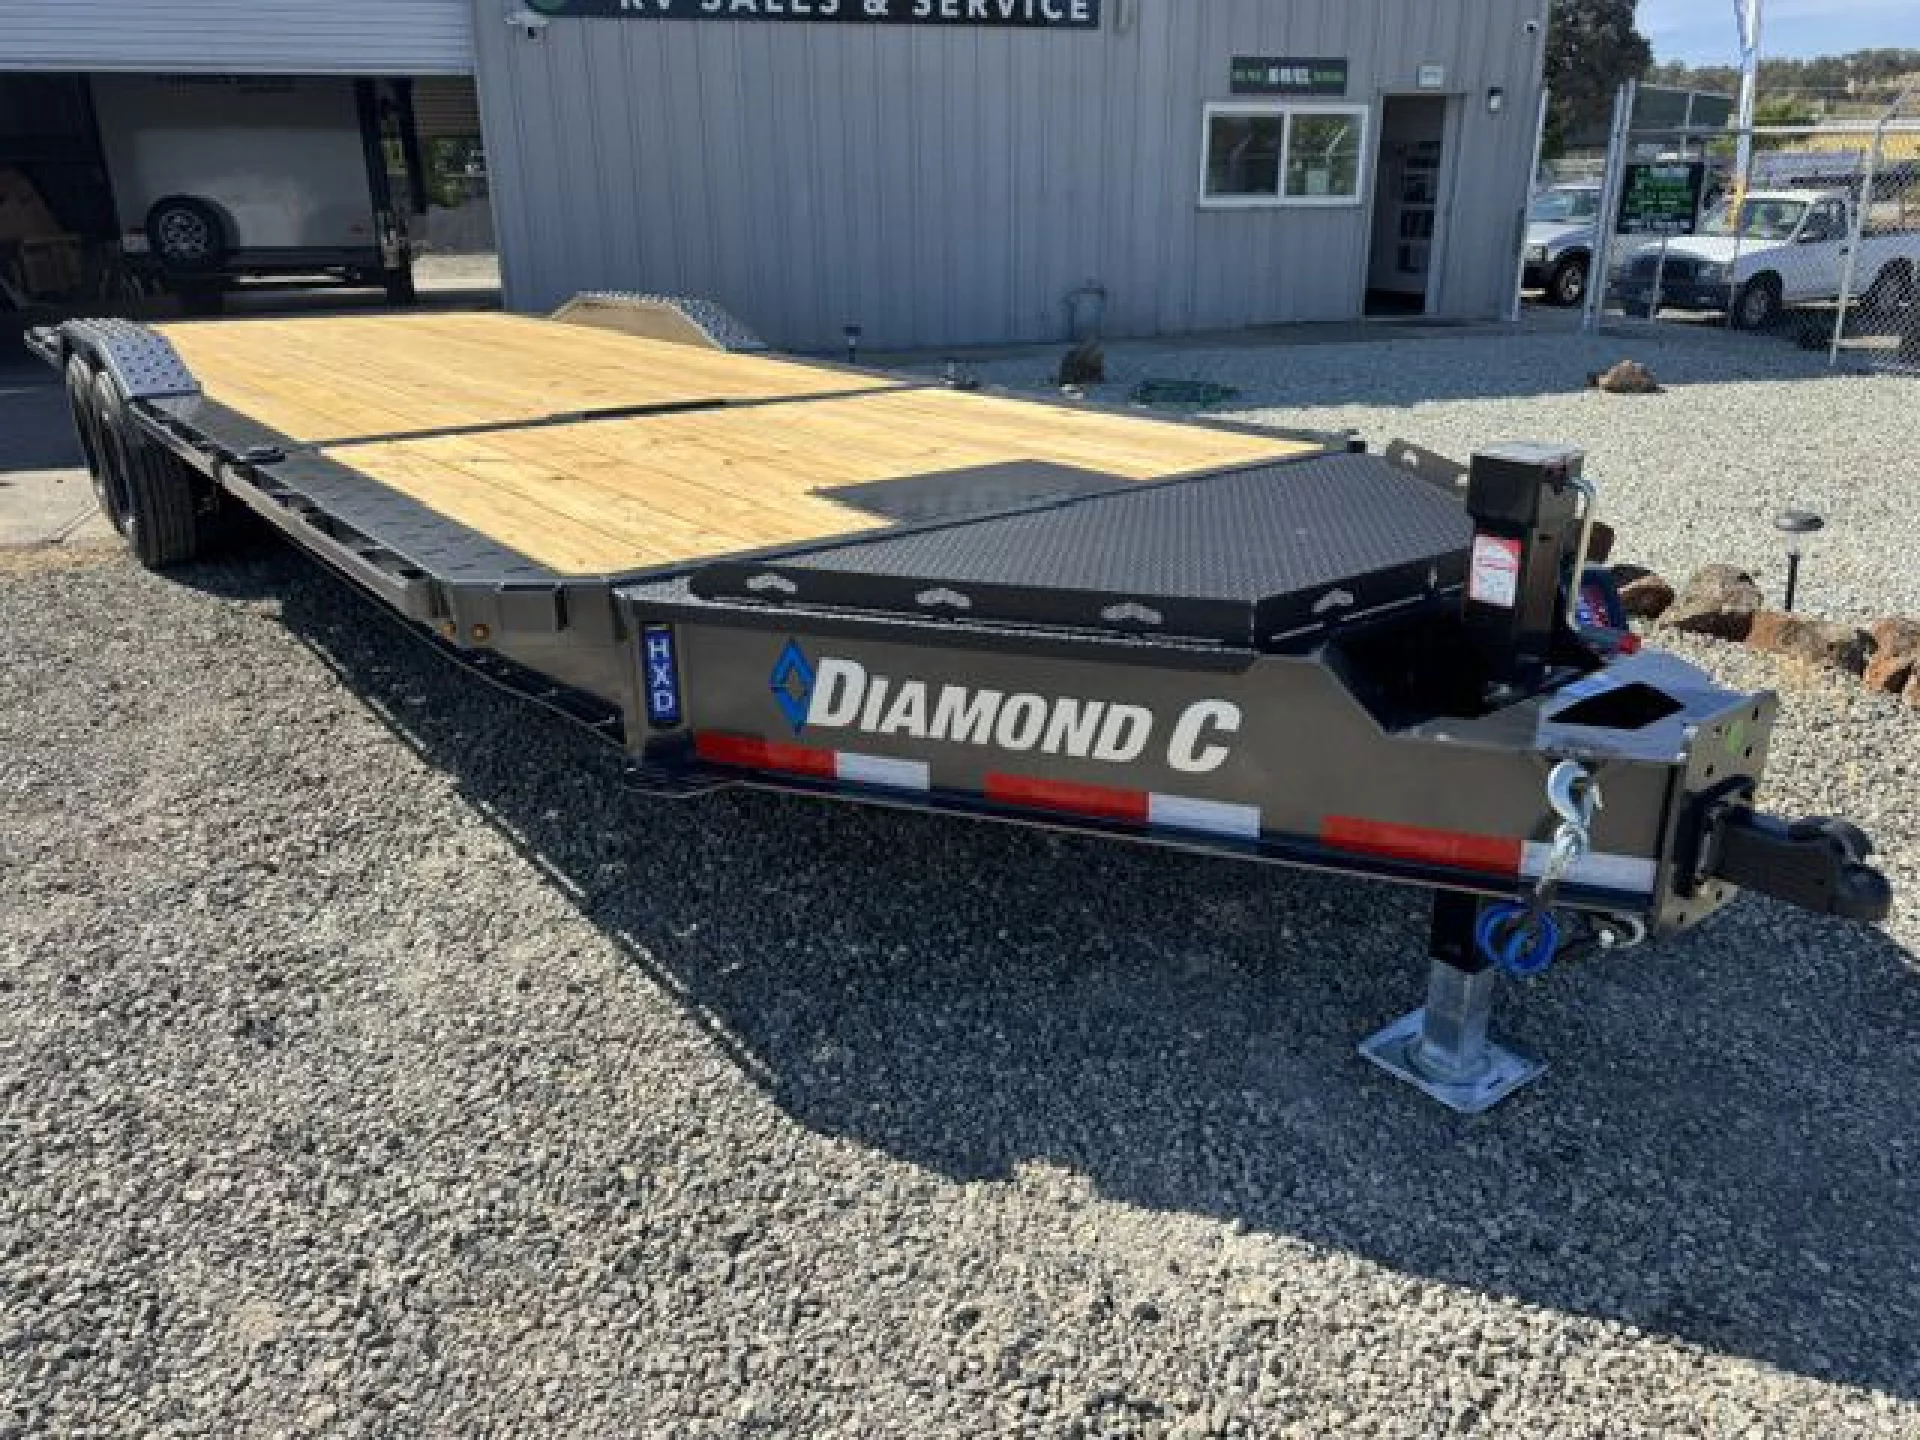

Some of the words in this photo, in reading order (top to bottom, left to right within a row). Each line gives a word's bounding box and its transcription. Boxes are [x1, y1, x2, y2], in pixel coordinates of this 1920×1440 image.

[912, 0, 1090, 21] SERVICE
[647, 638, 673, 713] HXD
[806, 656, 1153, 763] DIAMOND
[1166, 698, 1243, 773] C
